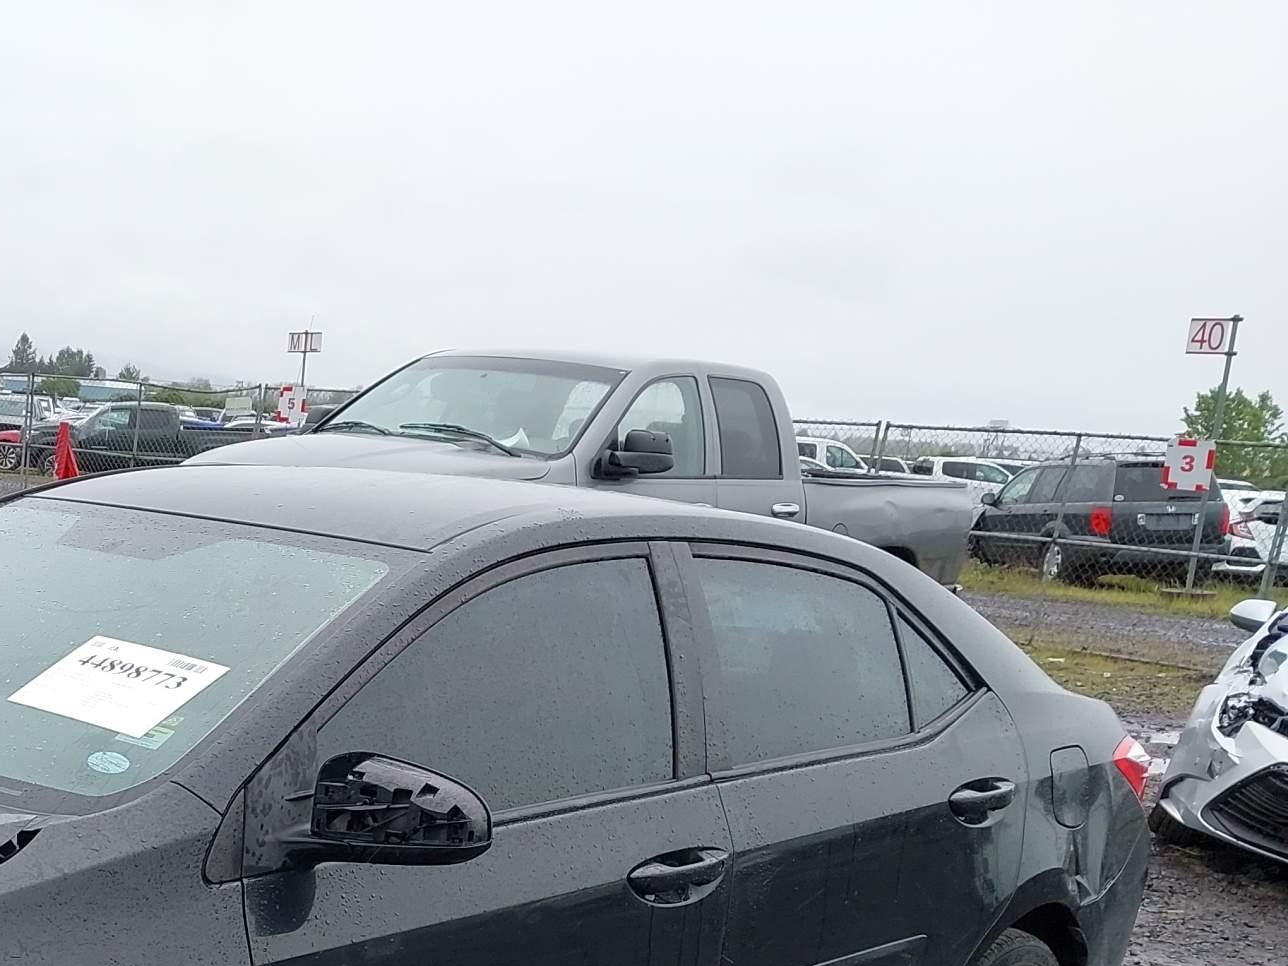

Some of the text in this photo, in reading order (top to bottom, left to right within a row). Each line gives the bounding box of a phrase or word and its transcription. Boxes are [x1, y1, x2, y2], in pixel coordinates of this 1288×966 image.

[1191, 321, 1225, 351] 40
[287, 398, 296, 410] 5
[1180, 455, 1195, 473] 3
[78, 654, 188, 690] 44898773
